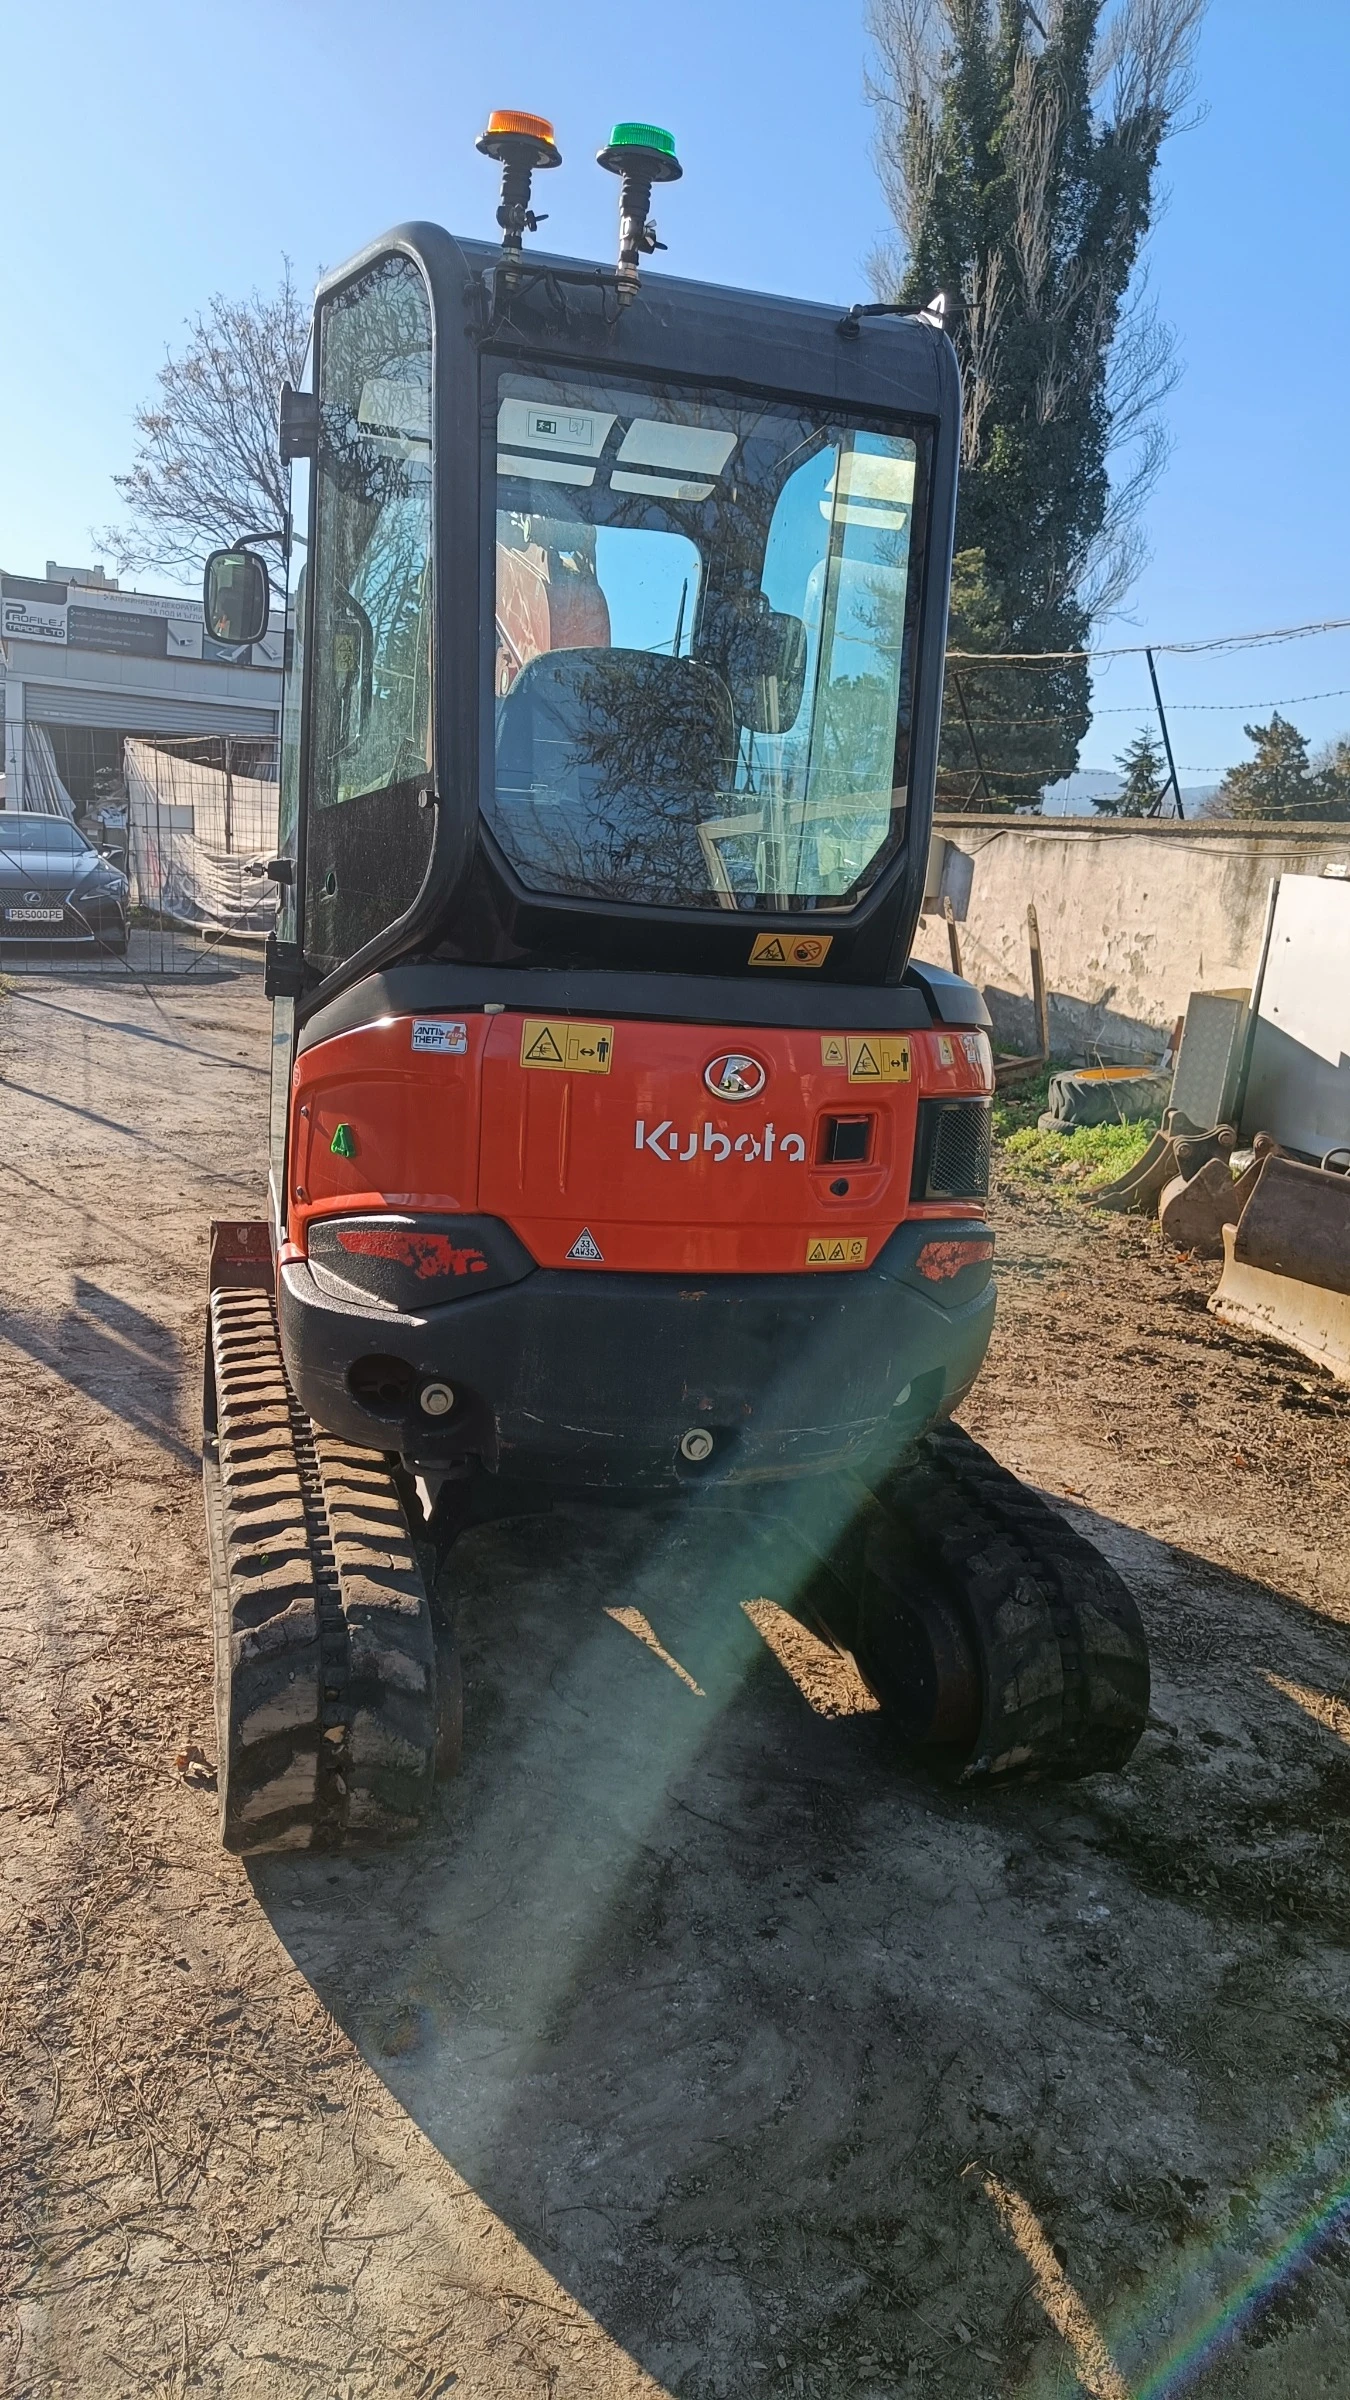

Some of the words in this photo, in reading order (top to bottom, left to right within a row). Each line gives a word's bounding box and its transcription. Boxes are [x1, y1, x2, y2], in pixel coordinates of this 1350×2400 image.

[161, 602, 204, 613] ДЕКОРАТИВ
[7, 623, 41, 634] TRADE
[43, 628, 64, 637] LTD
[414, 1027, 438, 1035] ANTI
[414, 1036, 444, 1044] THEFT
[635, 1120, 806, 1162] Kubota
[580, 1240, 590, 1248] 33
